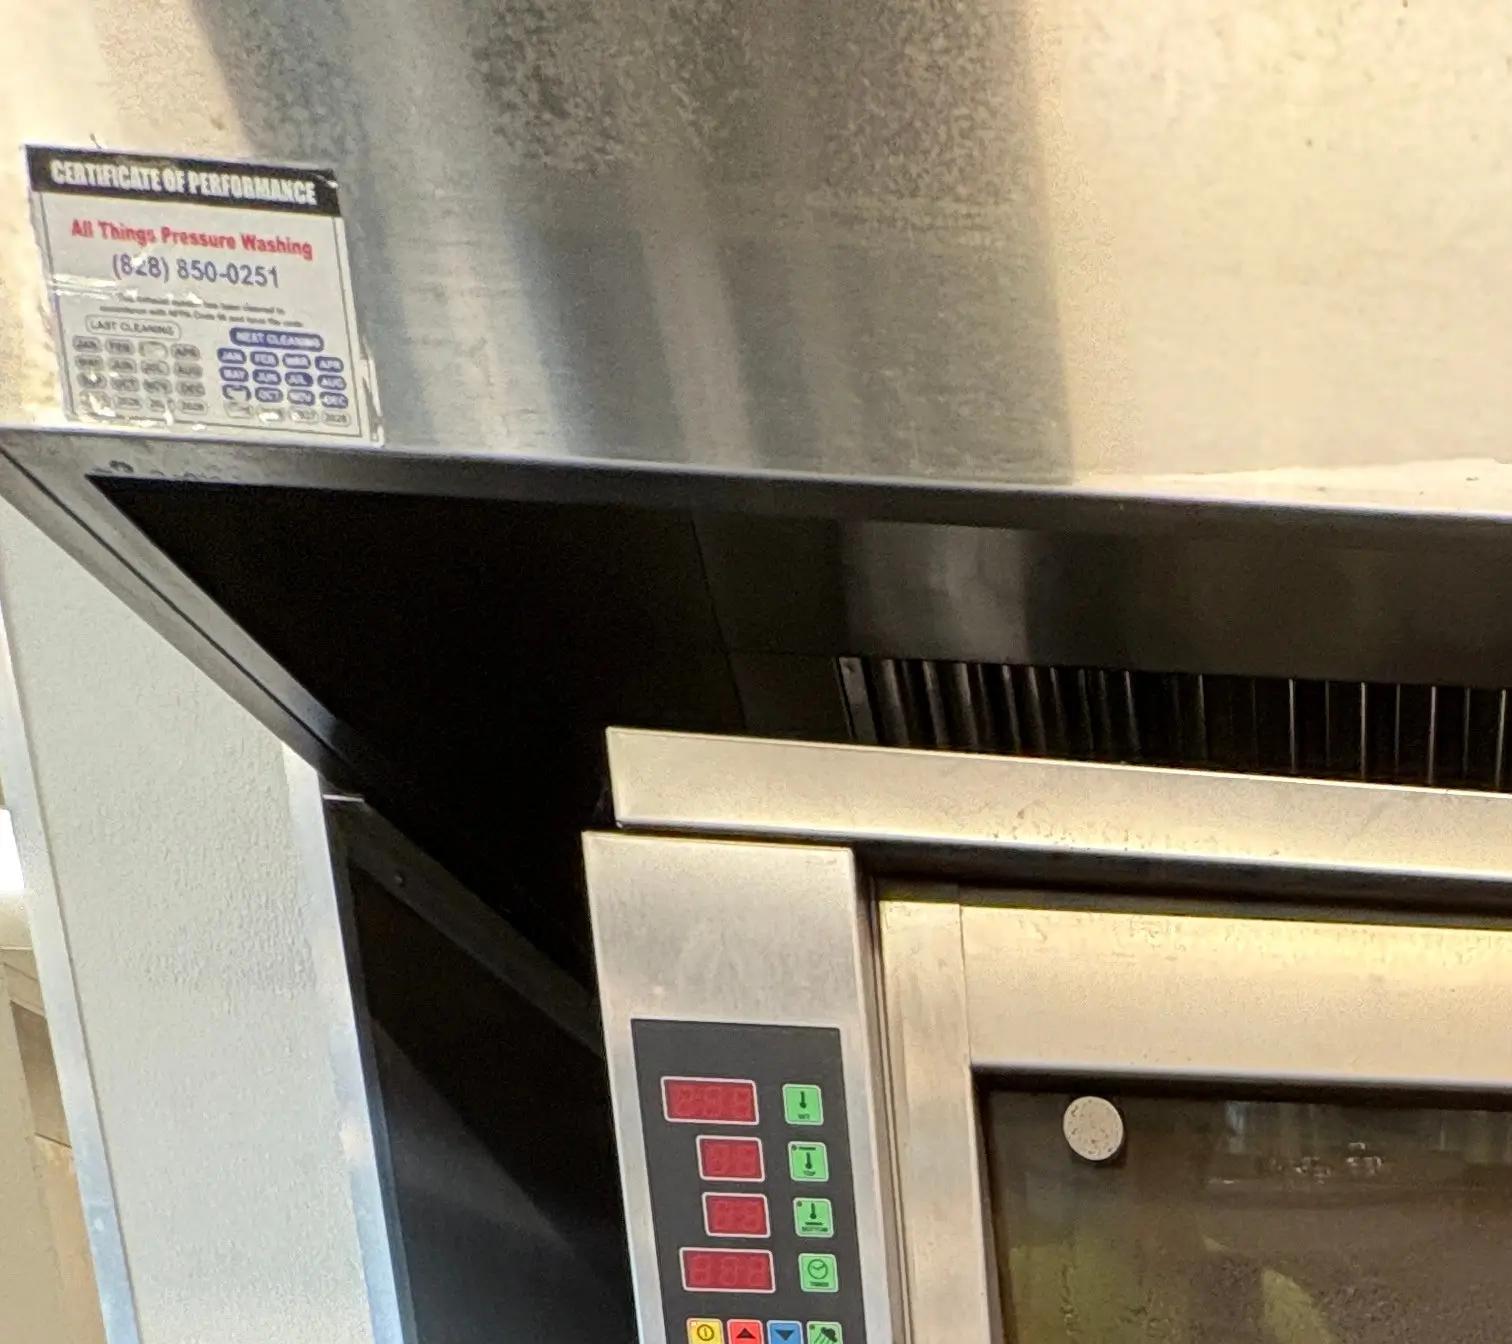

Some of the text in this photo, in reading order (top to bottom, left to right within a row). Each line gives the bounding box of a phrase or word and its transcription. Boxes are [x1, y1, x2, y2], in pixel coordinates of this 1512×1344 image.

[51, 160, 318, 205] CERTIFICATE OF PERFORMANCE
[71, 220, 313, 260] All Things Pressure Washing
[177, 259, 280, 288] 850-0251
[91, 321, 175, 336] LAST CLEANING
